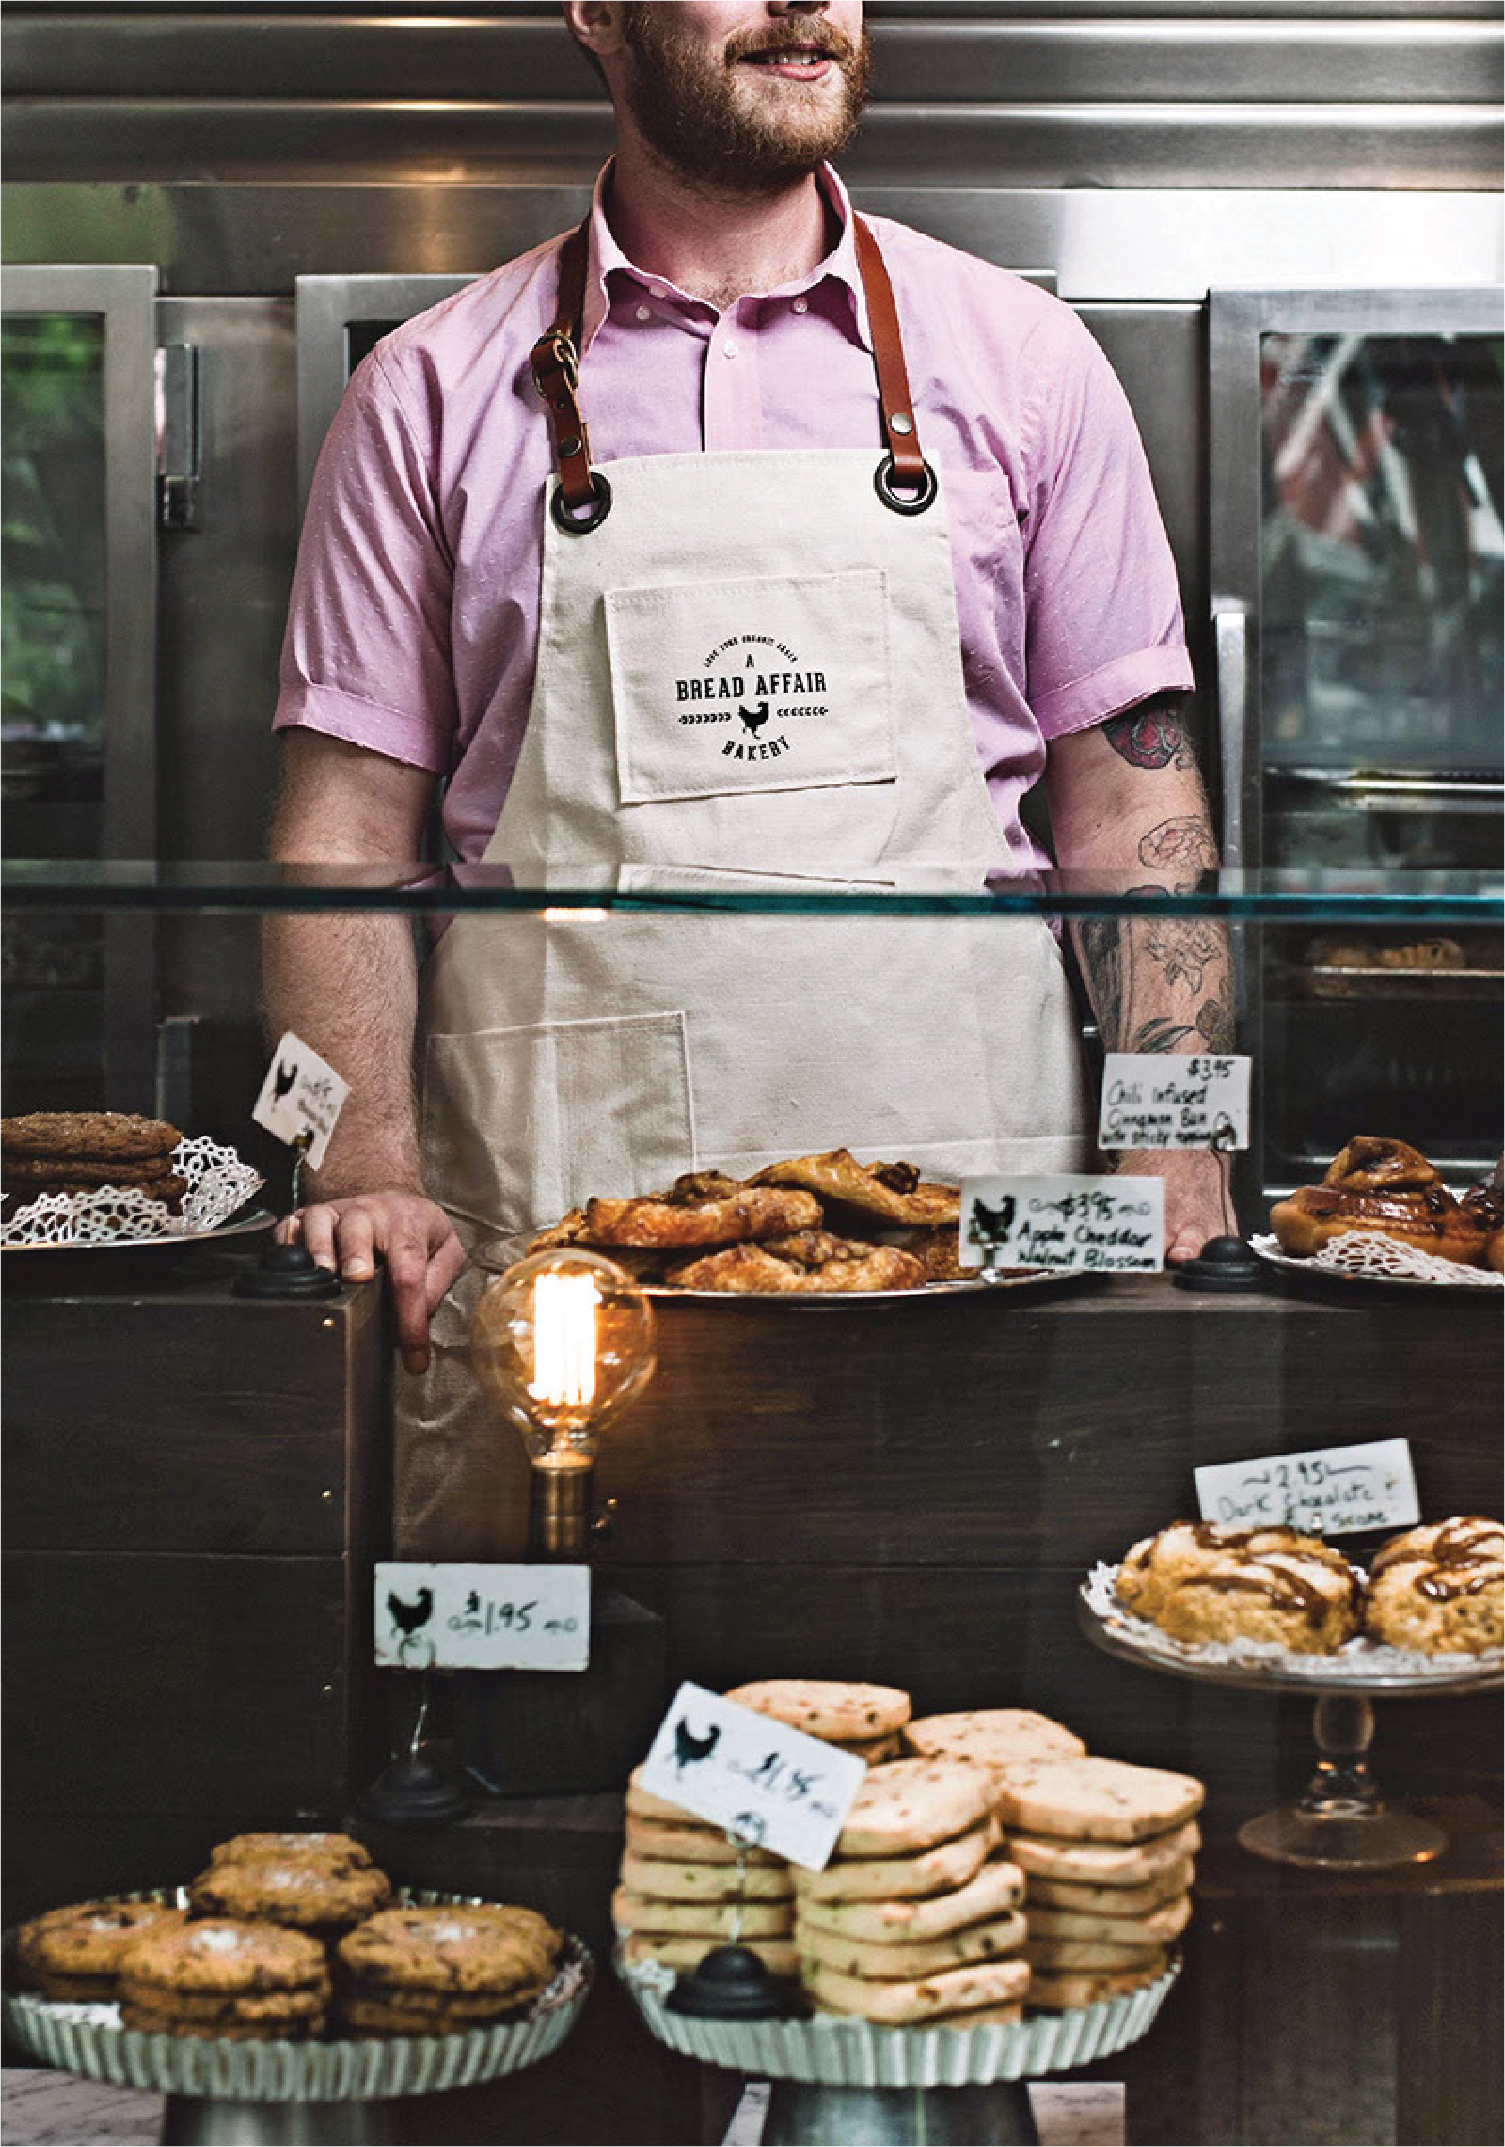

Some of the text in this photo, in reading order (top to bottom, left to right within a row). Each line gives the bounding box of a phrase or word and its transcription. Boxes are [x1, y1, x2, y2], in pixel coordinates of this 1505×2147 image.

[745, 654, 755, 668] A
[675, 672, 827, 702] BREAD AFFAIR
[721, 735, 791, 761] BAKERY
[1016, 1221, 1153, 1250] Apple Cheddar
